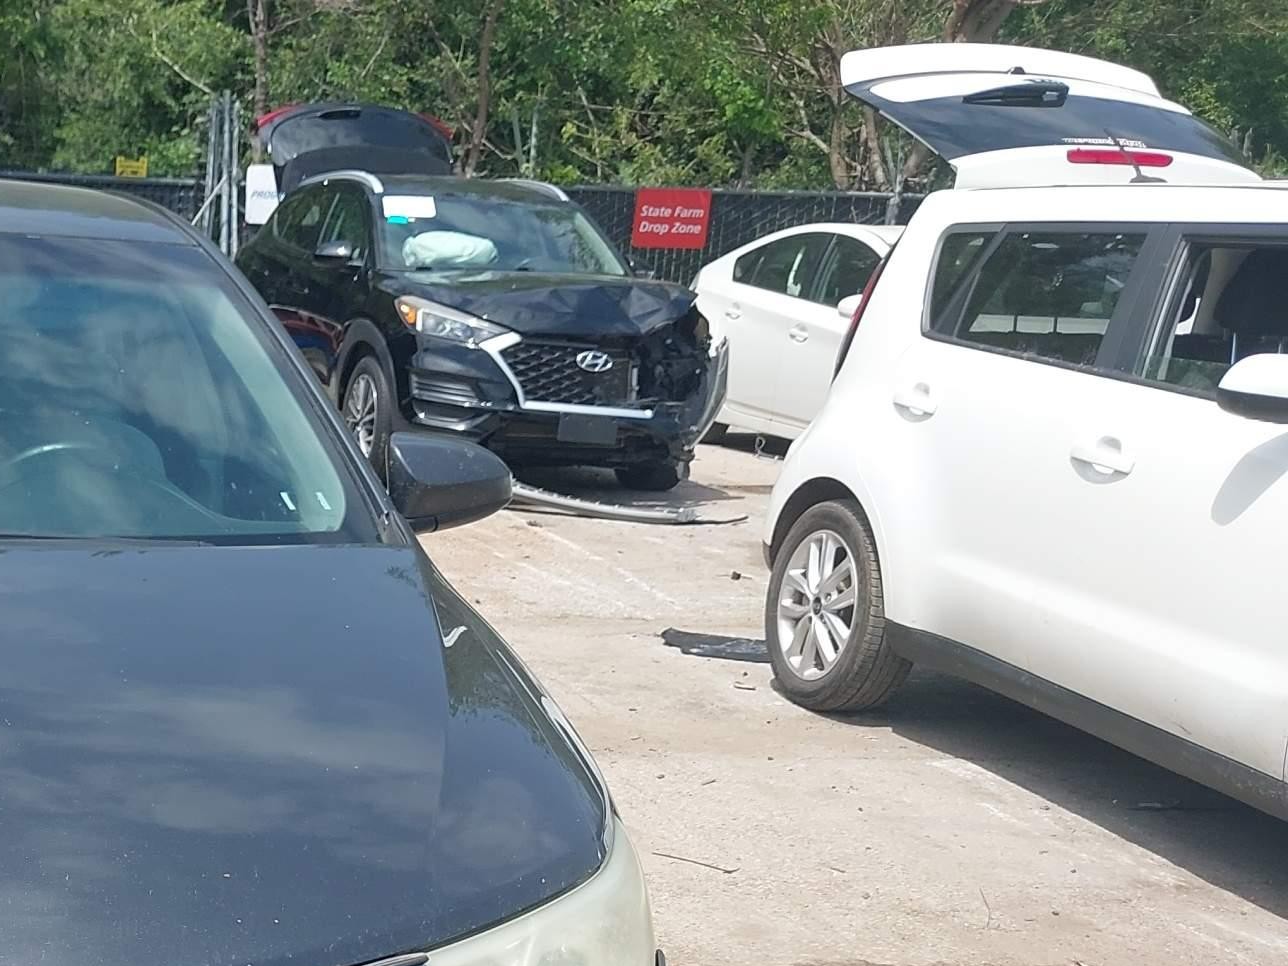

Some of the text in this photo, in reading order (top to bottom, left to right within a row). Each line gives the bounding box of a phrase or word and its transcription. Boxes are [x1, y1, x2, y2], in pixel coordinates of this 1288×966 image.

[640, 205, 704, 218] State Farm
[639, 221, 702, 235] Drop Zone
